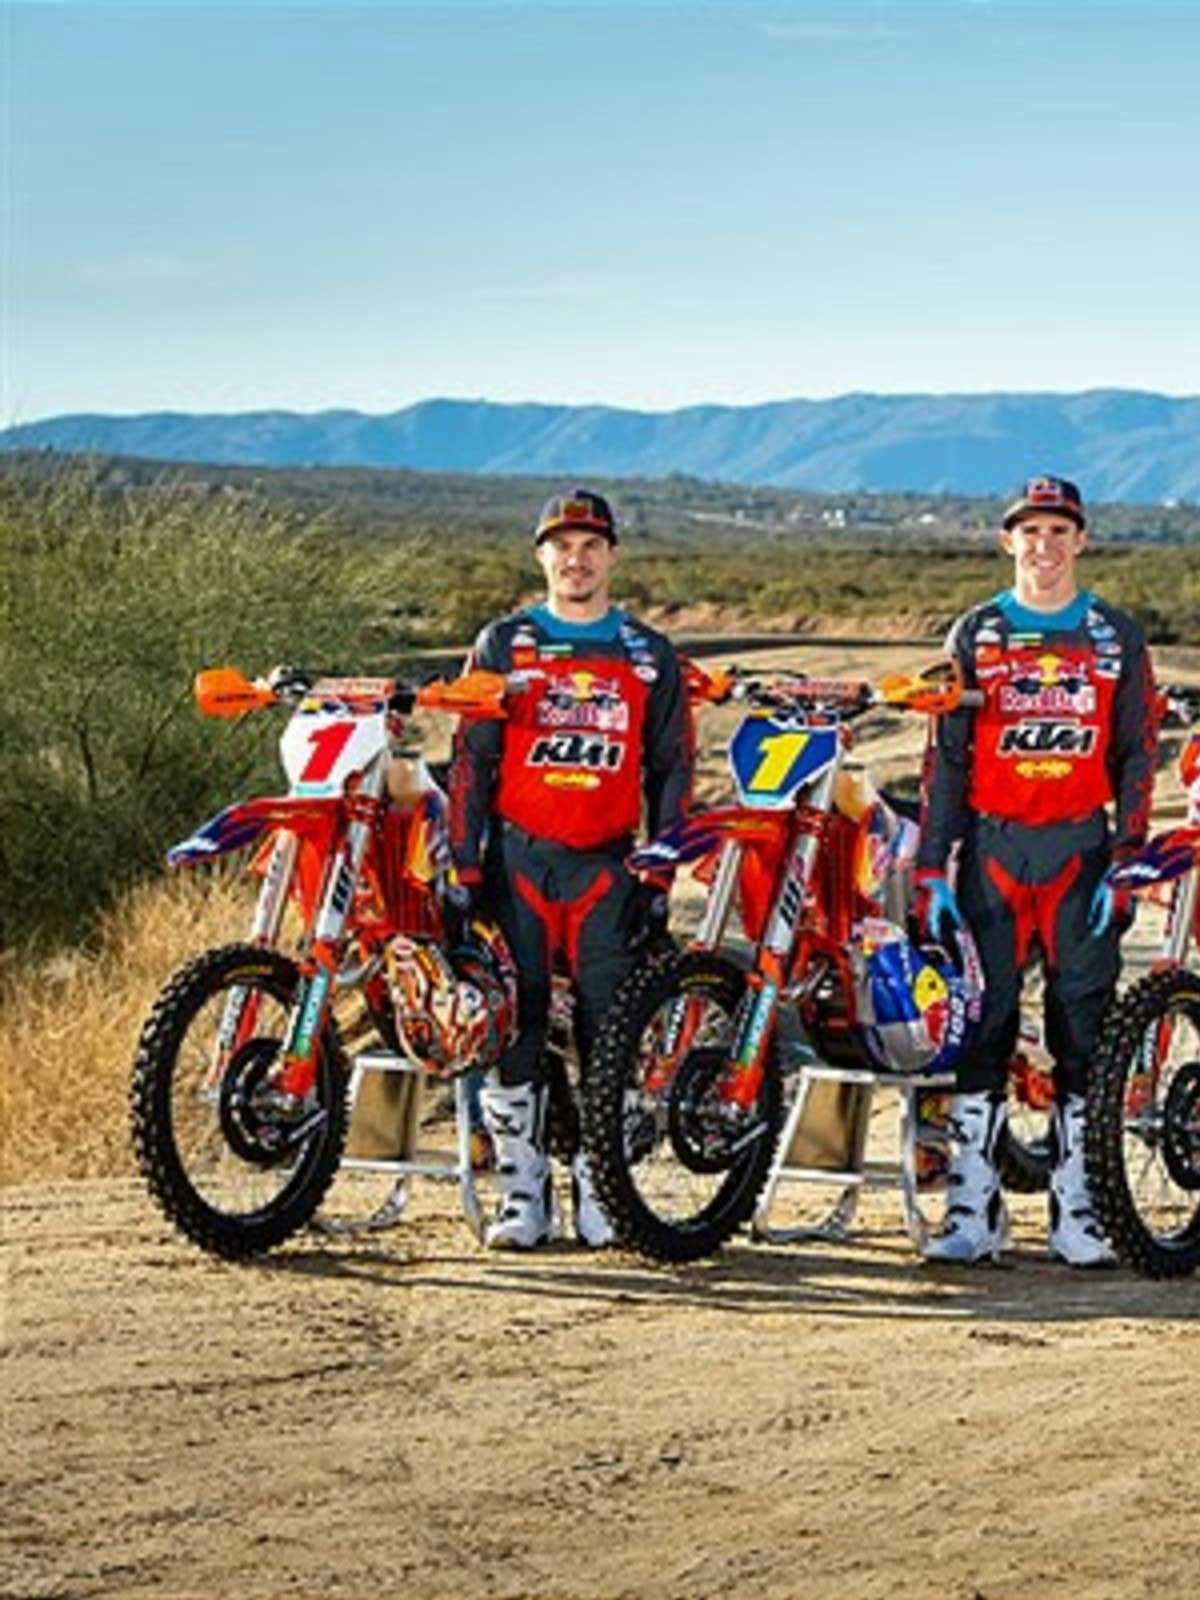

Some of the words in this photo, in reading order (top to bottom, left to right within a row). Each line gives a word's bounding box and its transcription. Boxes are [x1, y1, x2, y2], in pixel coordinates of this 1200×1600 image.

[300, 722, 357, 782] 1
[750, 732, 810, 790] 1
[996, 717, 1099, 757] KTM
